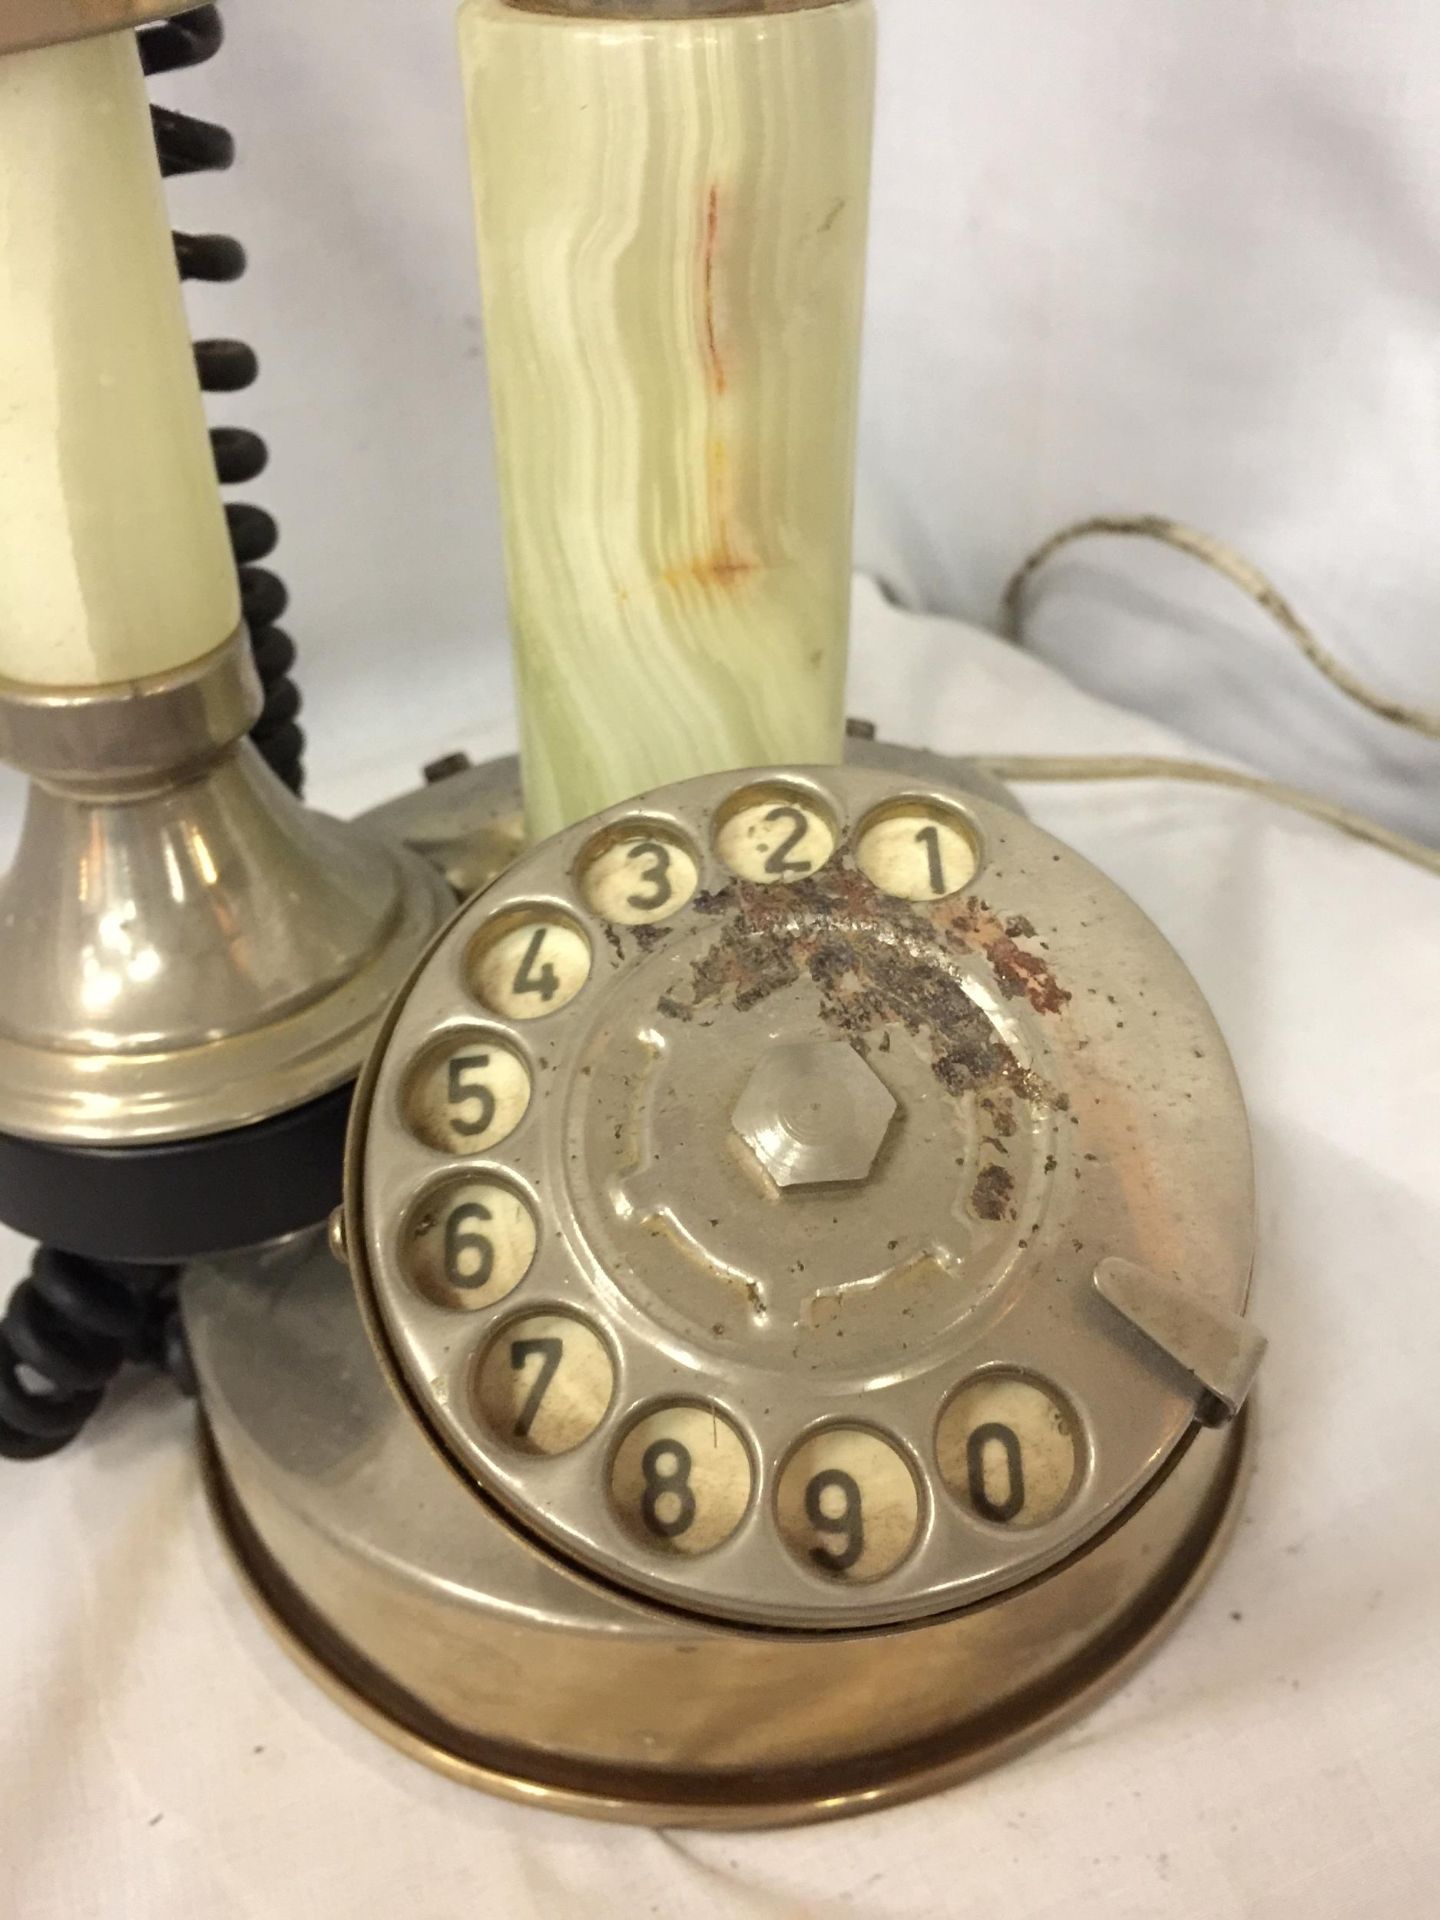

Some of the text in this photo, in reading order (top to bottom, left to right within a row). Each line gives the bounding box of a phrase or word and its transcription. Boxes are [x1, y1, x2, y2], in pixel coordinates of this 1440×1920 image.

[627, 842, 673, 911] 3
[764, 807, 812, 875] 2
[914, 825, 946, 894] 1
[512, 928, 560, 1001] 4
[447, 1054, 495, 1135] 5
[443, 1203, 493, 1289] 6
[509, 1336, 563, 1436] 7
[641, 1438, 696, 1538] 8
[967, 1422, 1024, 1523] 0
[805, 1468, 863, 1573] 9
